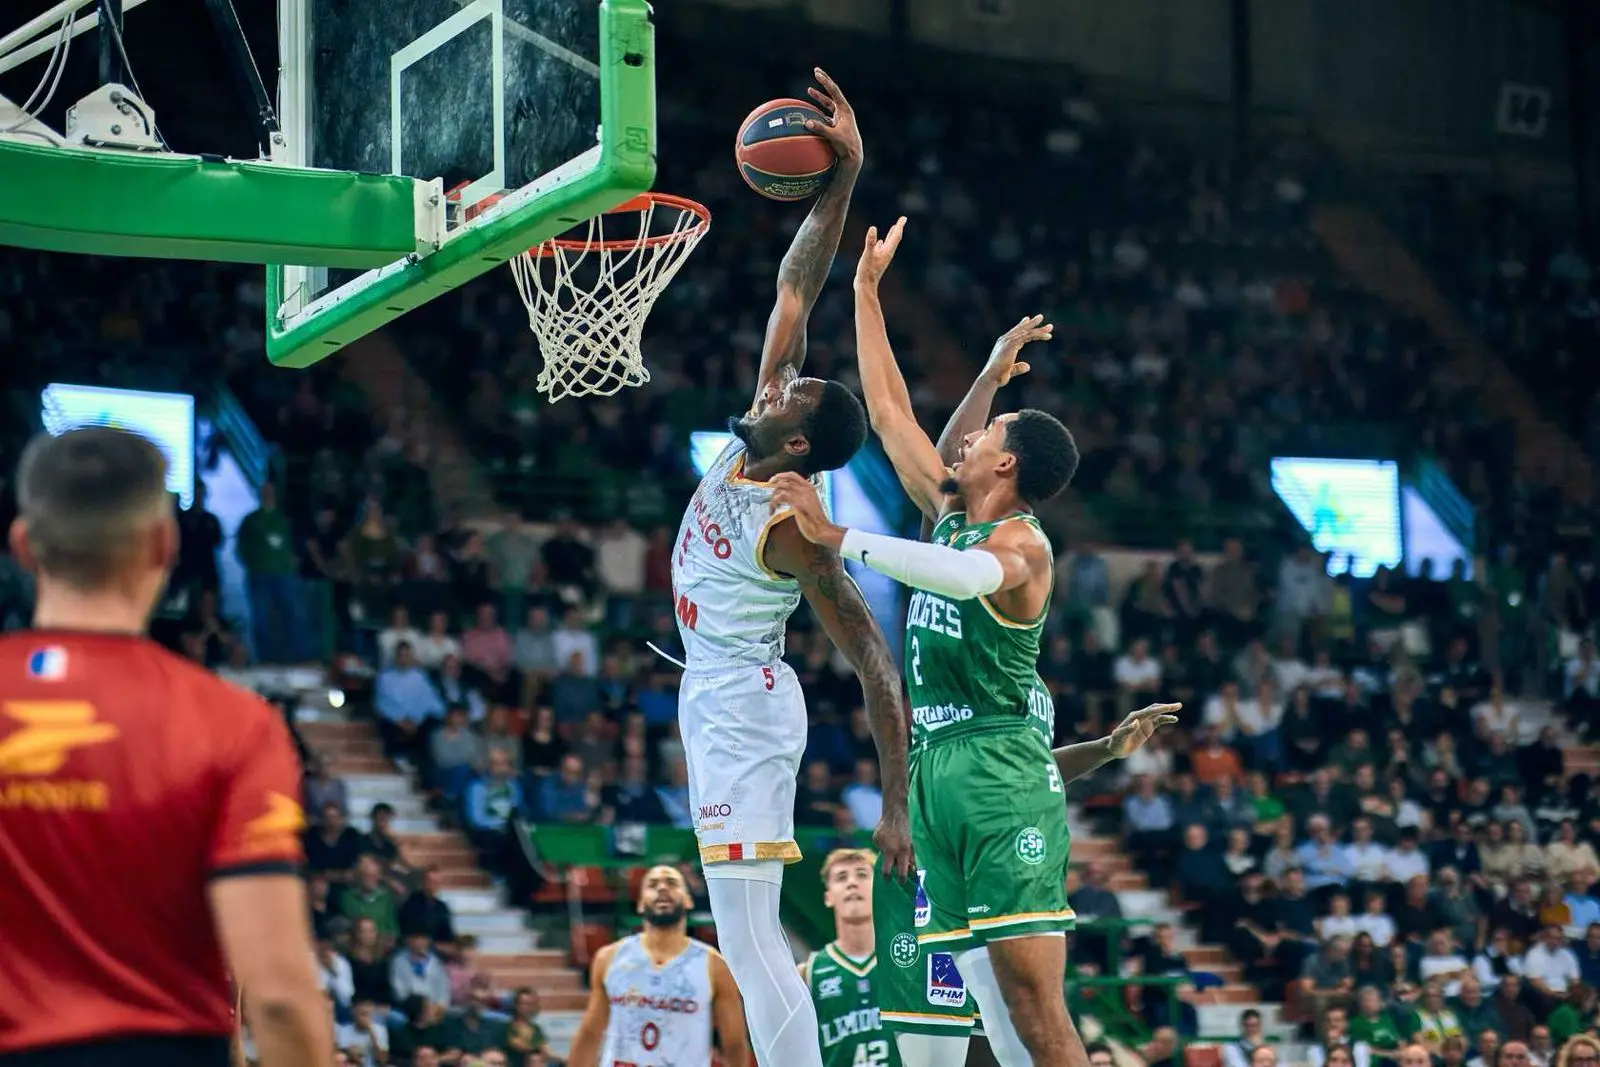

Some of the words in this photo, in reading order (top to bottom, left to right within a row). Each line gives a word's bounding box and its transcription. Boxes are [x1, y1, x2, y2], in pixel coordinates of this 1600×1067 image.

[911, 635, 923, 686] 2
[761, 666, 775, 691] 5
[1045, 763, 1062, 793] 2
[1020, 834, 1043, 853] CSP
[893, 939, 916, 957] CSP
[930, 989, 964, 999] PHM
[641, 1021, 661, 1052] 0
